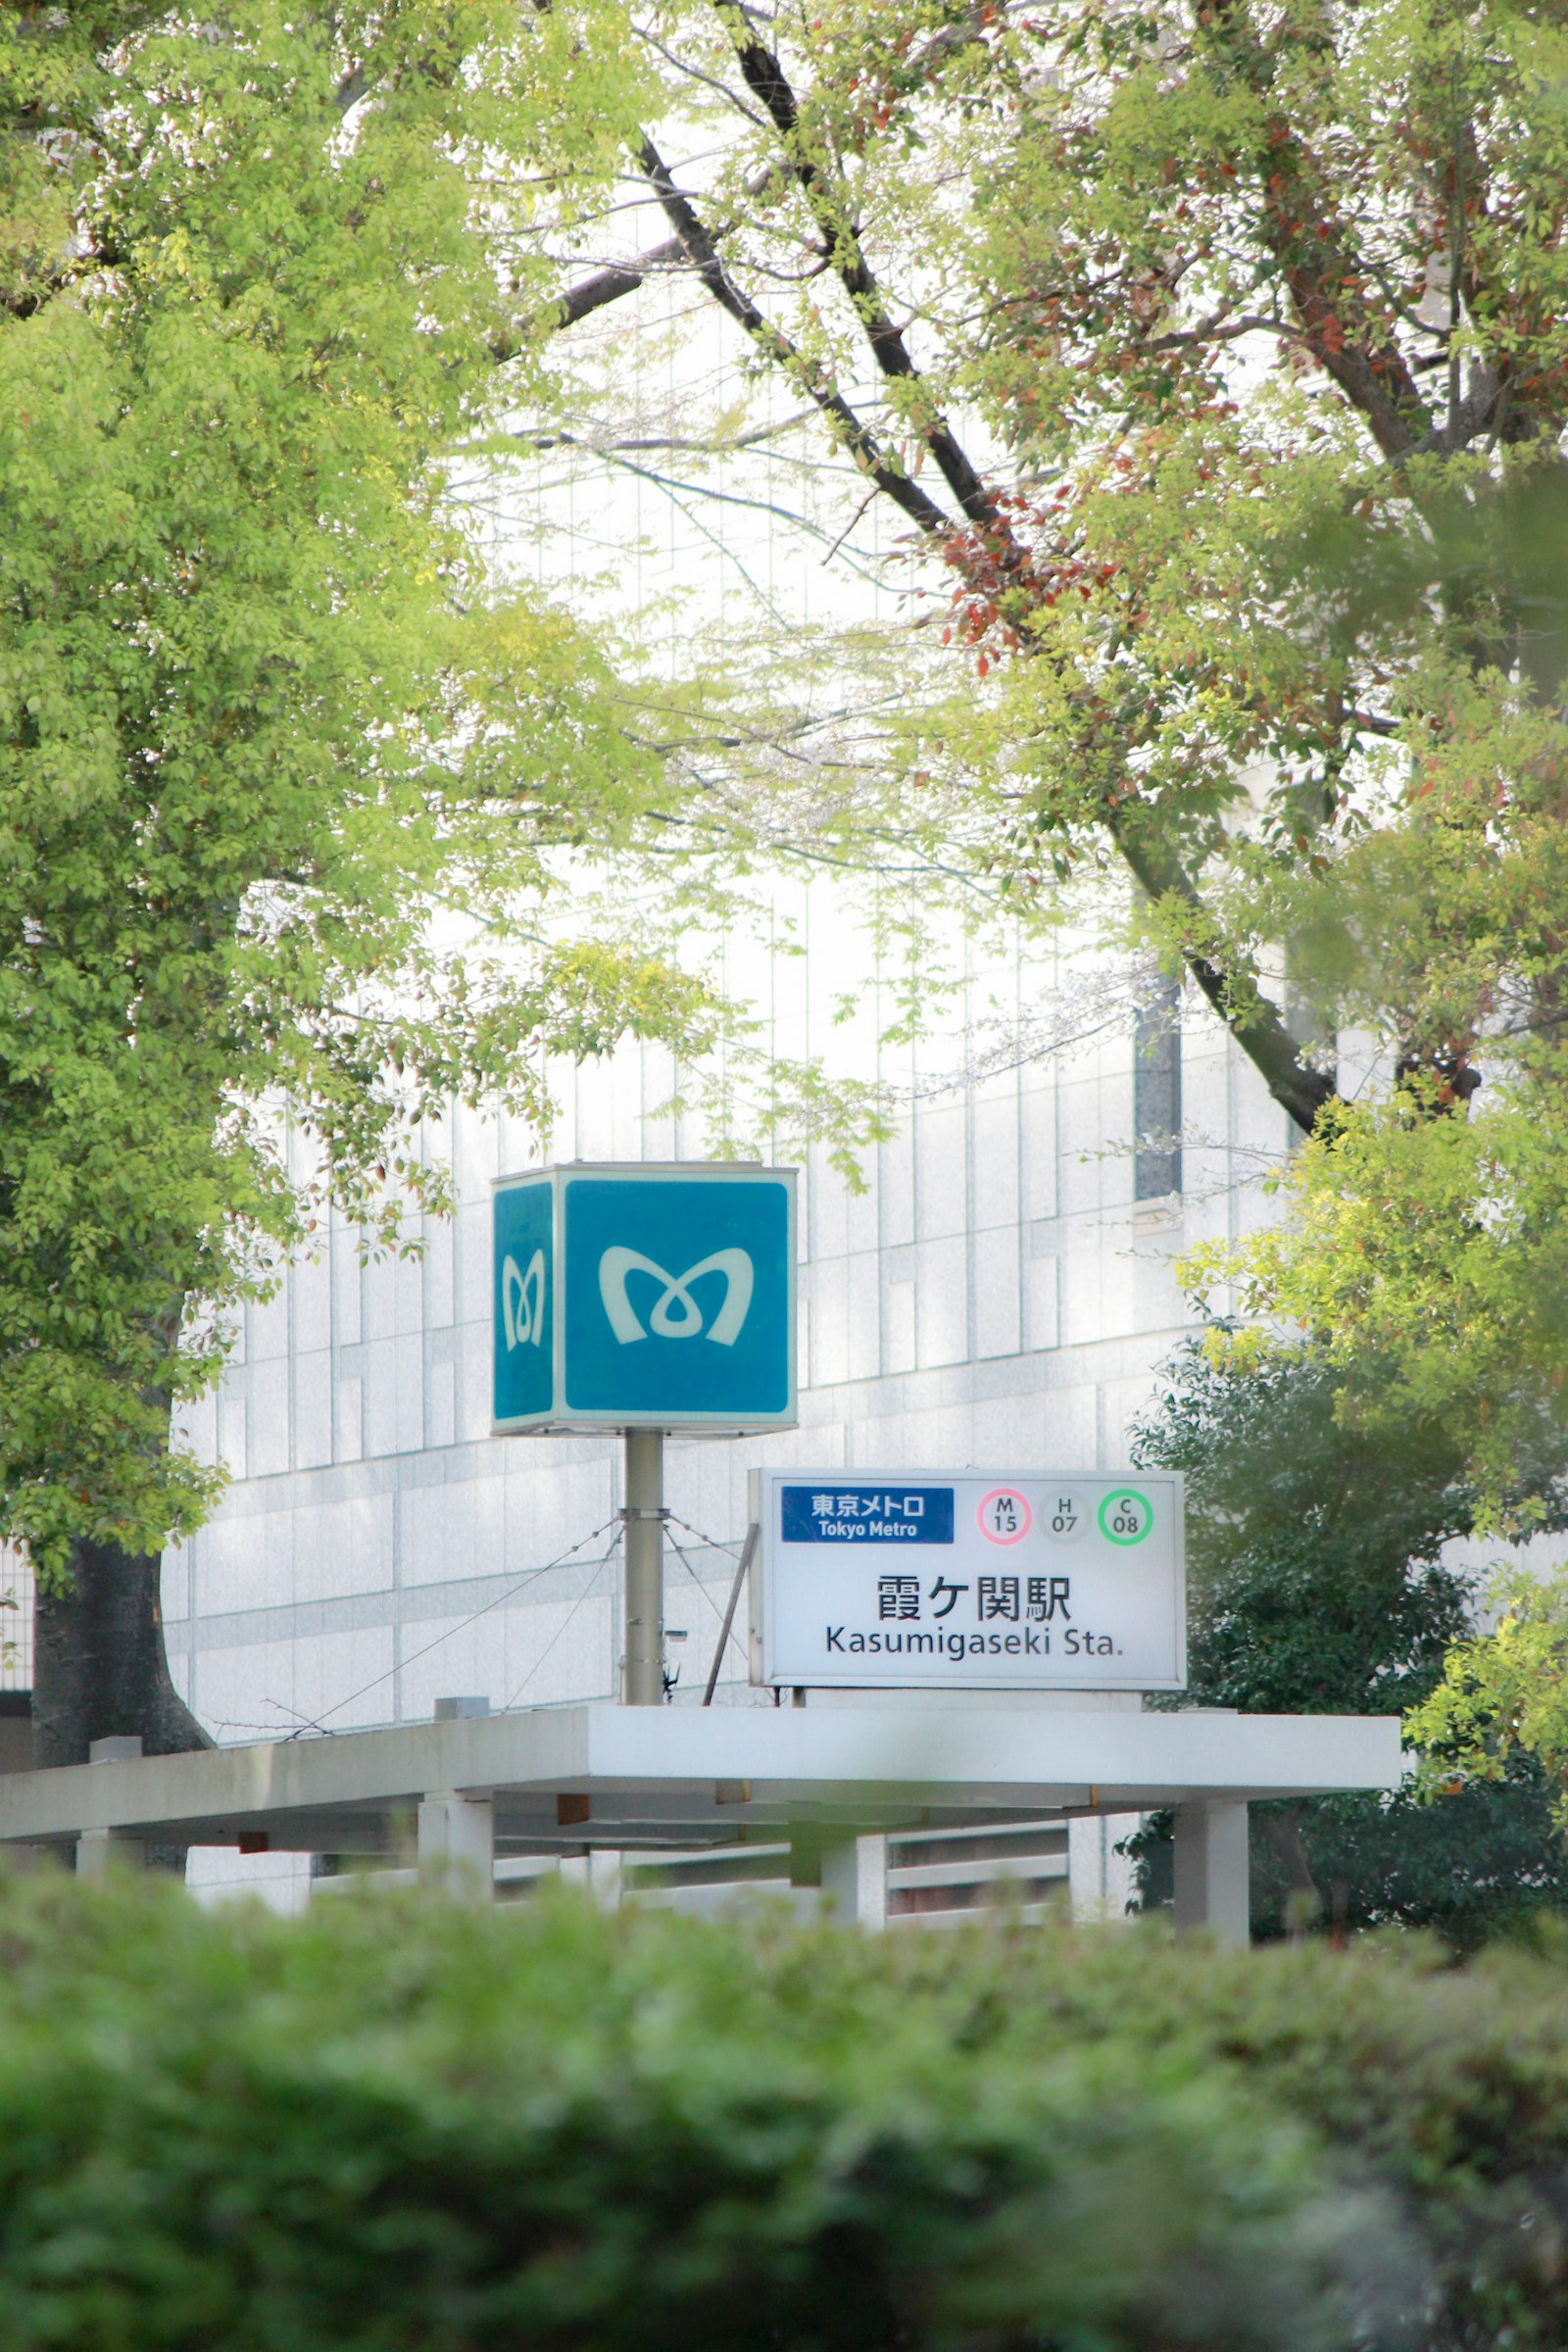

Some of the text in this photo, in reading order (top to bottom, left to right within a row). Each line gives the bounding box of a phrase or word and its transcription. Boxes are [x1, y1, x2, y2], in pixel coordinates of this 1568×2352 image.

[811, 1494, 925, 1517] 東京メトロ
[996, 1497, 1013, 1513] M
[1058, 1498, 1071, 1513] H
[1120, 1498, 1131, 1514] C
[819, 1520, 917, 1539] Tokyo Metro
[994, 1515, 1017, 1533] 15
[1052, 1515, 1078, 1534] 07
[1112, 1516, 1139, 1534] 08
[825, 1626, 1124, 1662] Kasumigaseki Sta.
